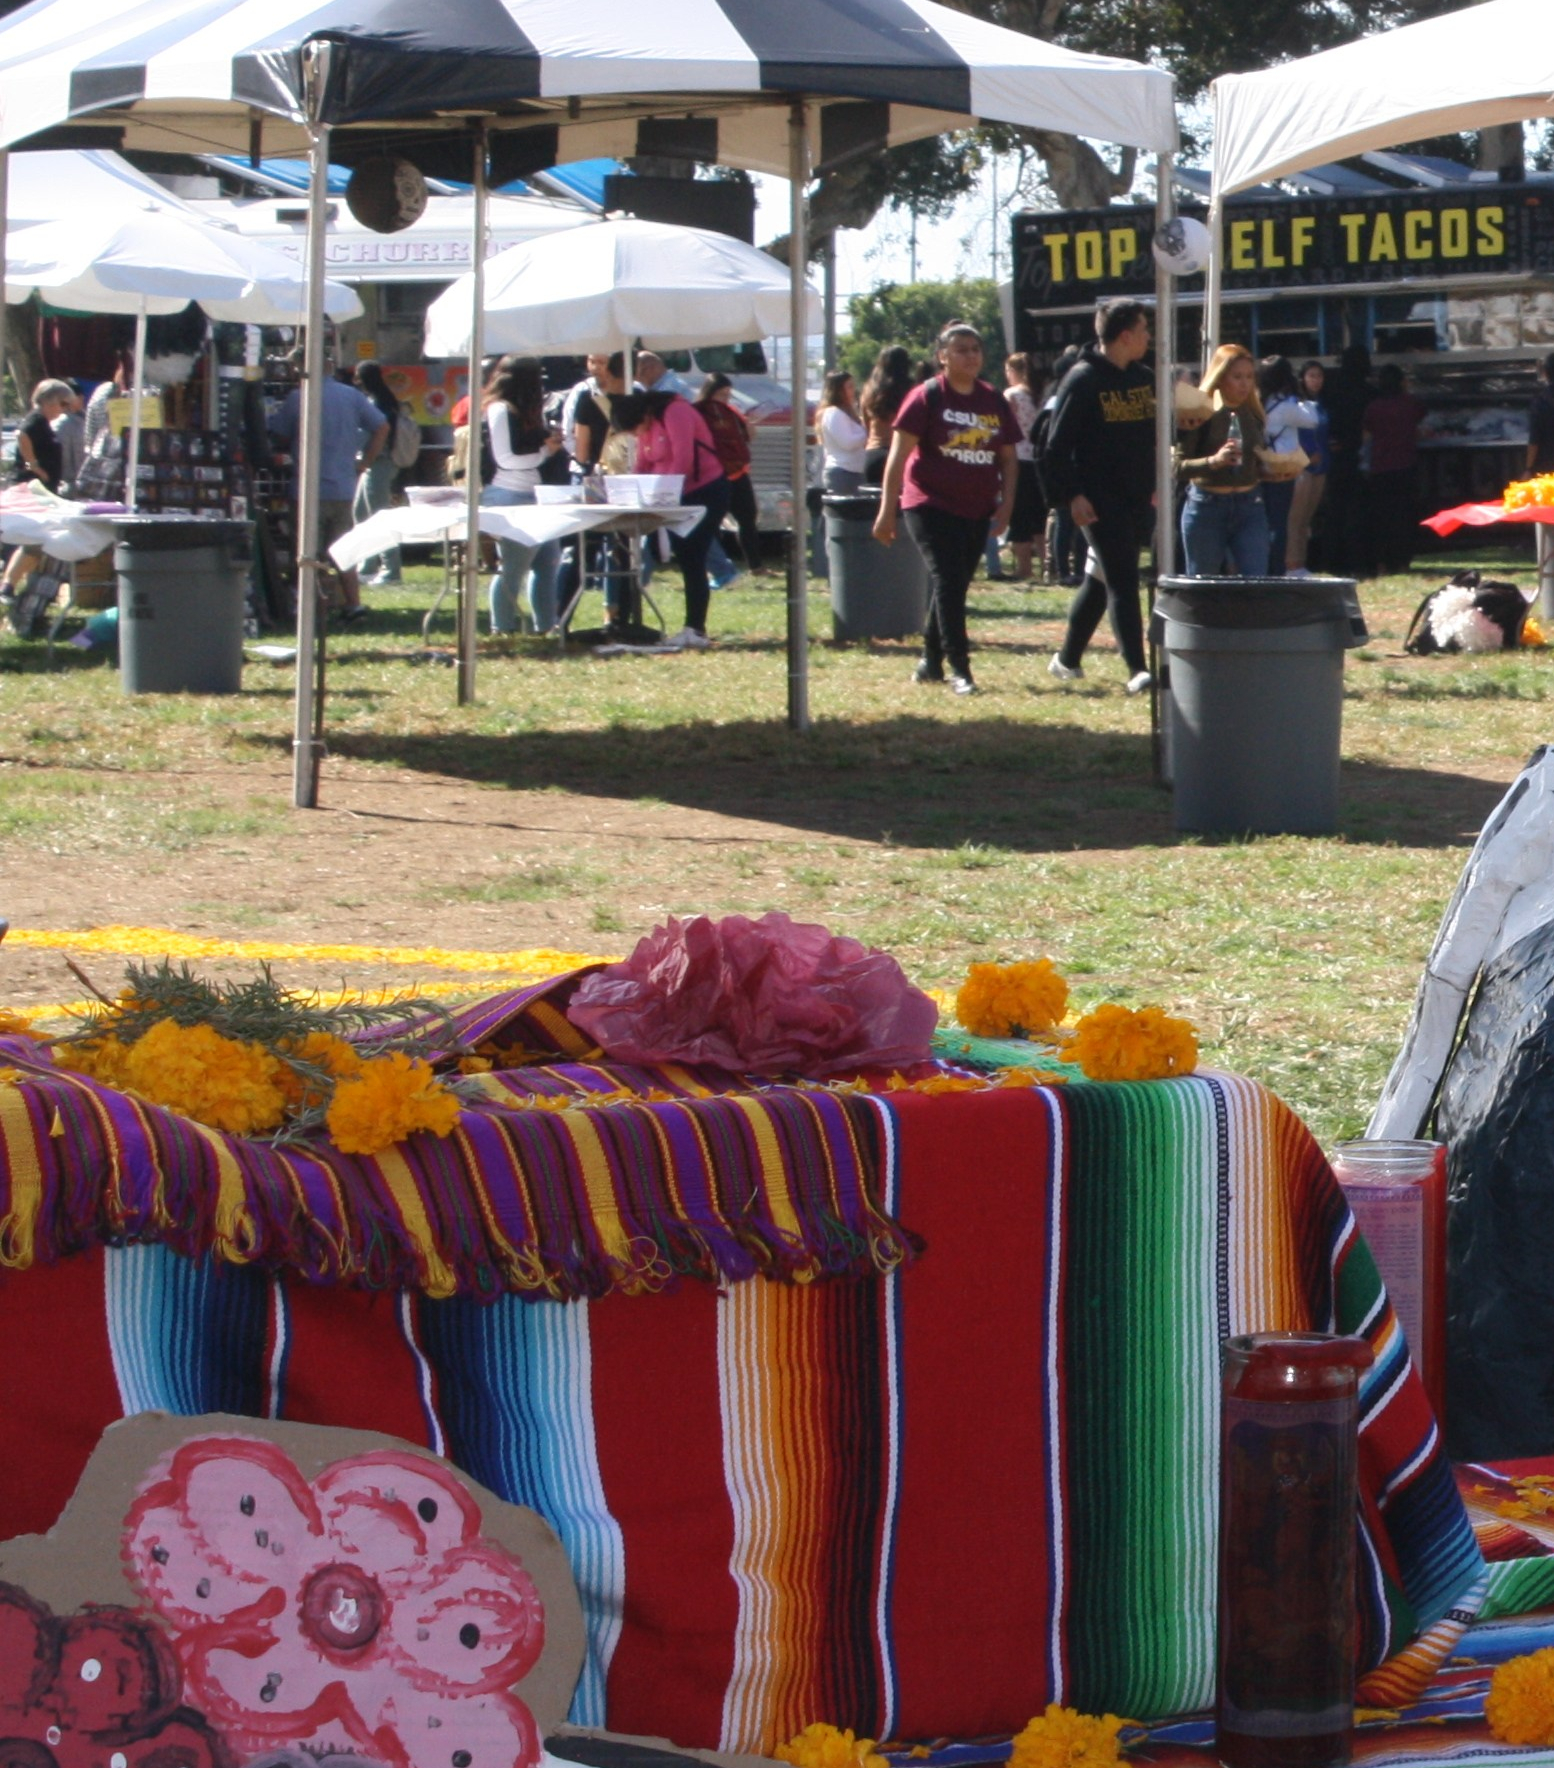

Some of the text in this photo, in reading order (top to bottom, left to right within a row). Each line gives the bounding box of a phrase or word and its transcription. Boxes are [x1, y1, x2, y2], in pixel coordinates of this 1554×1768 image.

[325, 240, 526, 263] CHURR
[1043, 228, 1137, 282] TOP
[1220, 216, 1316, 270] ELF
[1339, 206, 1504, 263] TACOS
[942, 408, 1000, 428] CSUDH
